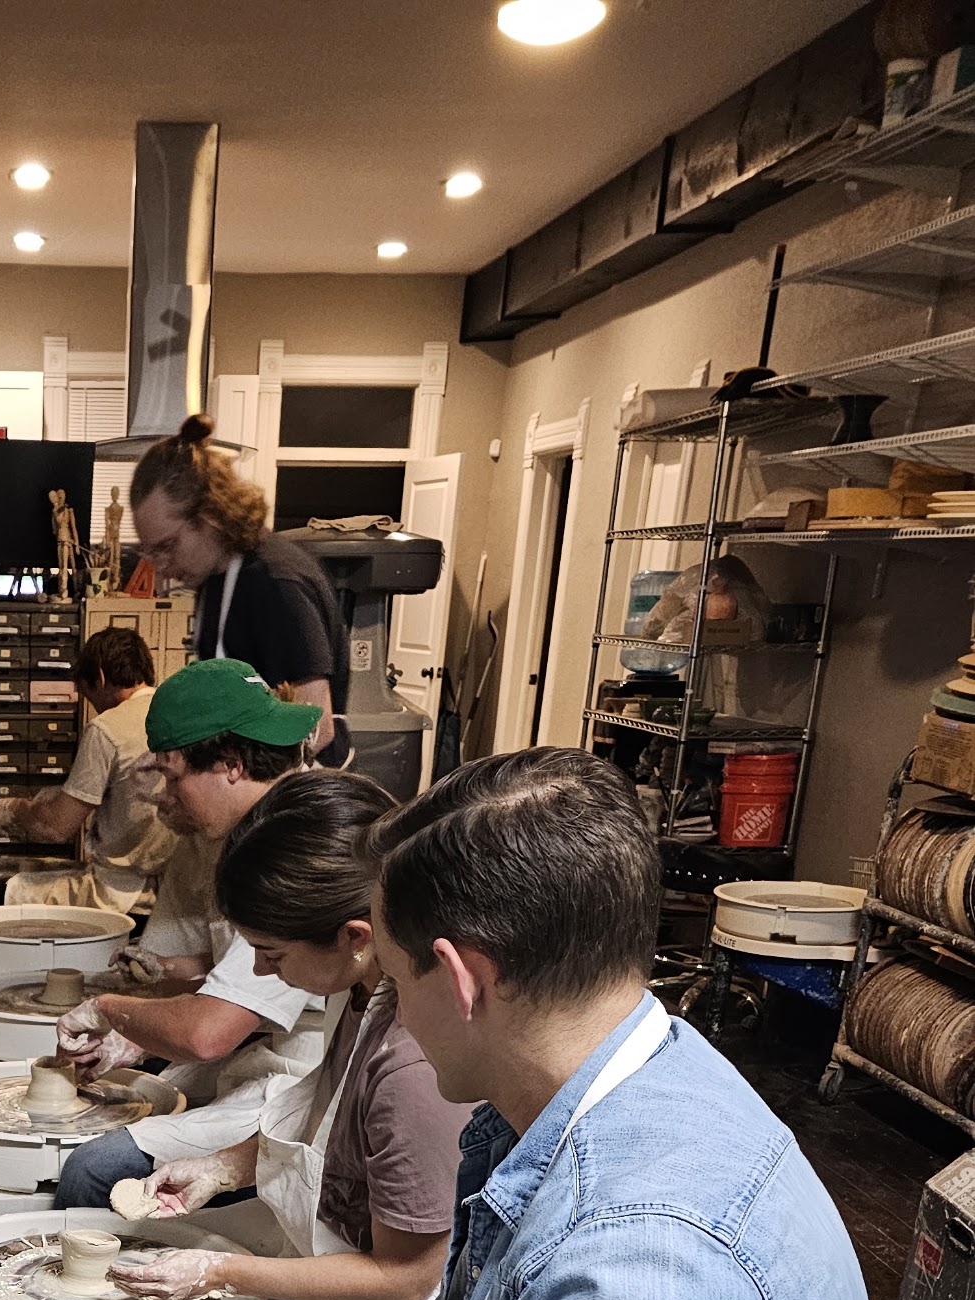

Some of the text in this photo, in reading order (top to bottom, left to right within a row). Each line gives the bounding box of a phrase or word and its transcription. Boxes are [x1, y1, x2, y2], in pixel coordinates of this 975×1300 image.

[733, 803, 775, 840] HOME
[739, 808, 756, 822] THE
[747, 818, 773, 840] DEPOT
